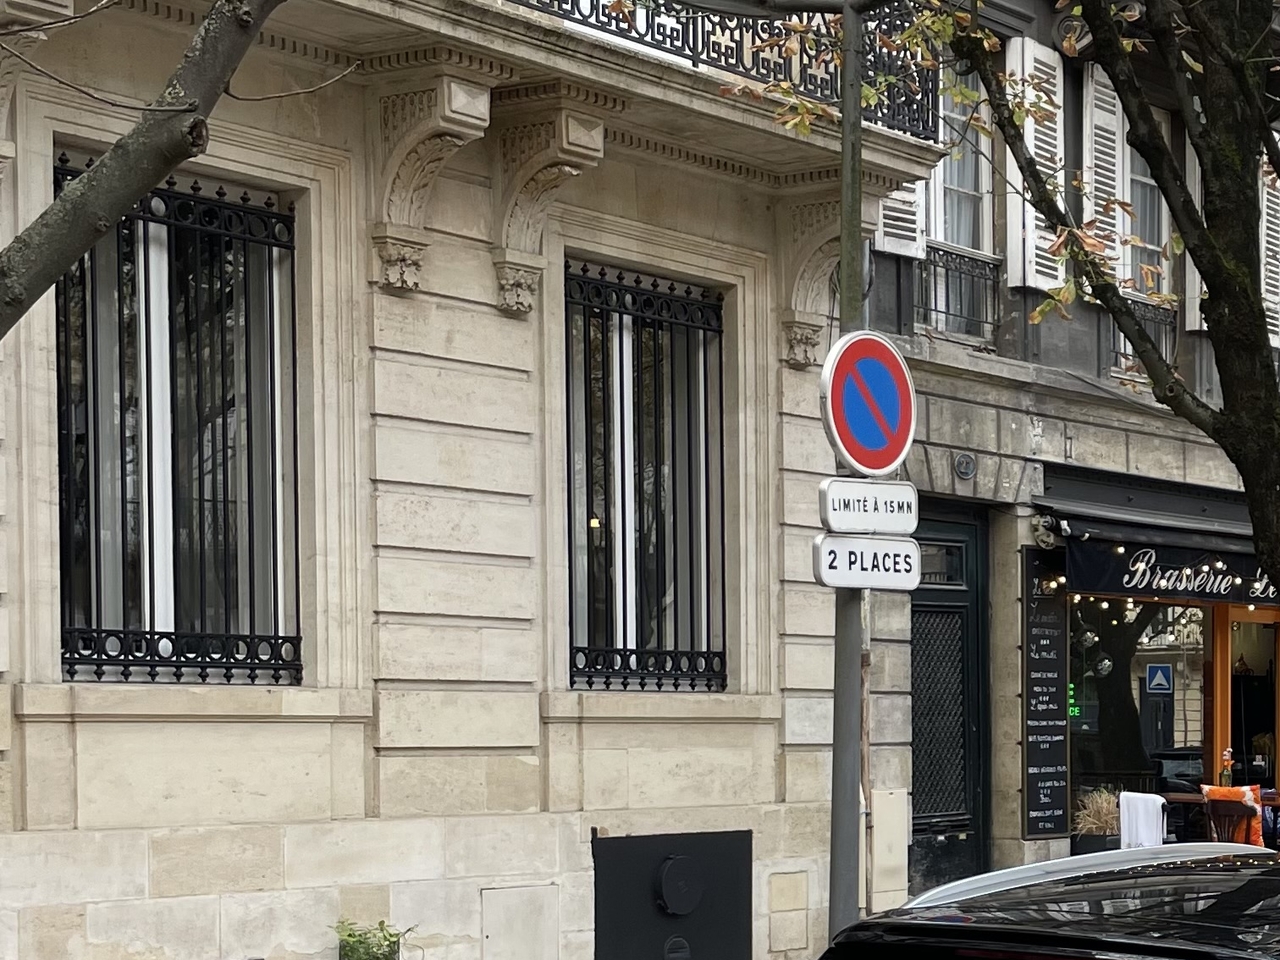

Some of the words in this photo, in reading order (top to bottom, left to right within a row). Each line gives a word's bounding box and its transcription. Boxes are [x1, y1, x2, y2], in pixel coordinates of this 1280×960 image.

[832, 496, 868, 513] LIMITÉ
[872, 496, 880, 513] À
[828, 550, 838, 570] 2
[848, 551, 913, 573] PLACES
[1123, 548, 1233, 595] Brasserie
